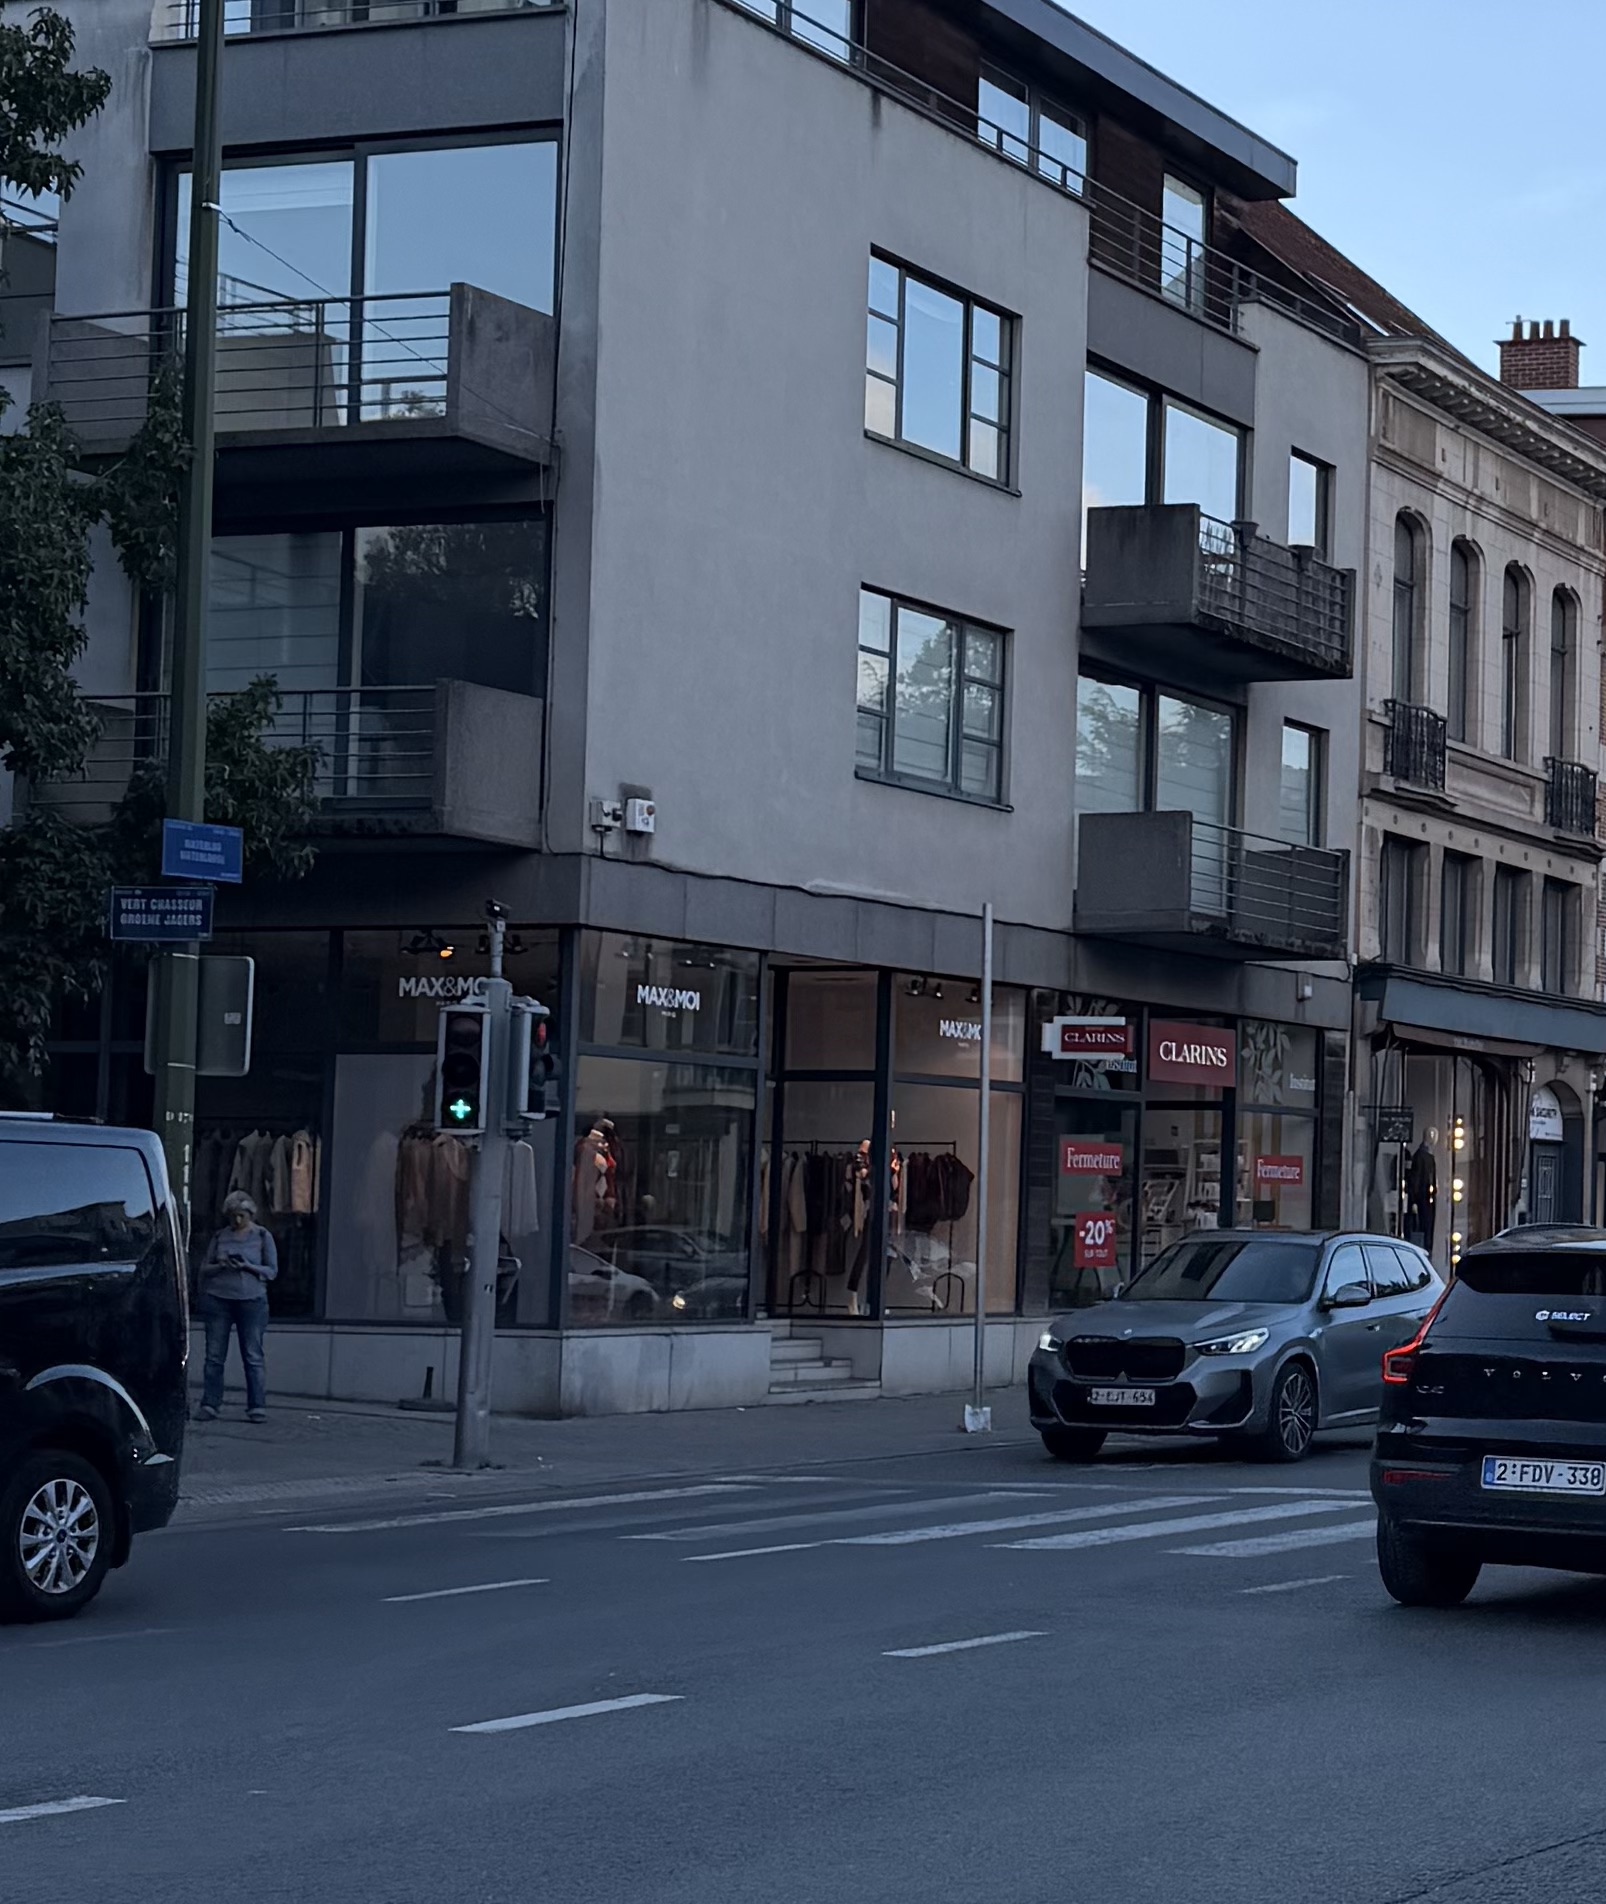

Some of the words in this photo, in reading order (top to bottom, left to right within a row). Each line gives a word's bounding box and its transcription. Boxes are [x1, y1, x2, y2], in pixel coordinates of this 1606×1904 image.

[637, 984, 700, 1011] MAX&MOI
[1064, 1032, 1126, 1044] CLARINS
[1159, 1041, 1227, 1067] CLARINS
[1066, 1148, 1120, 1170] Fermeture
[1256, 1159, 1300, 1180] Fermeture
